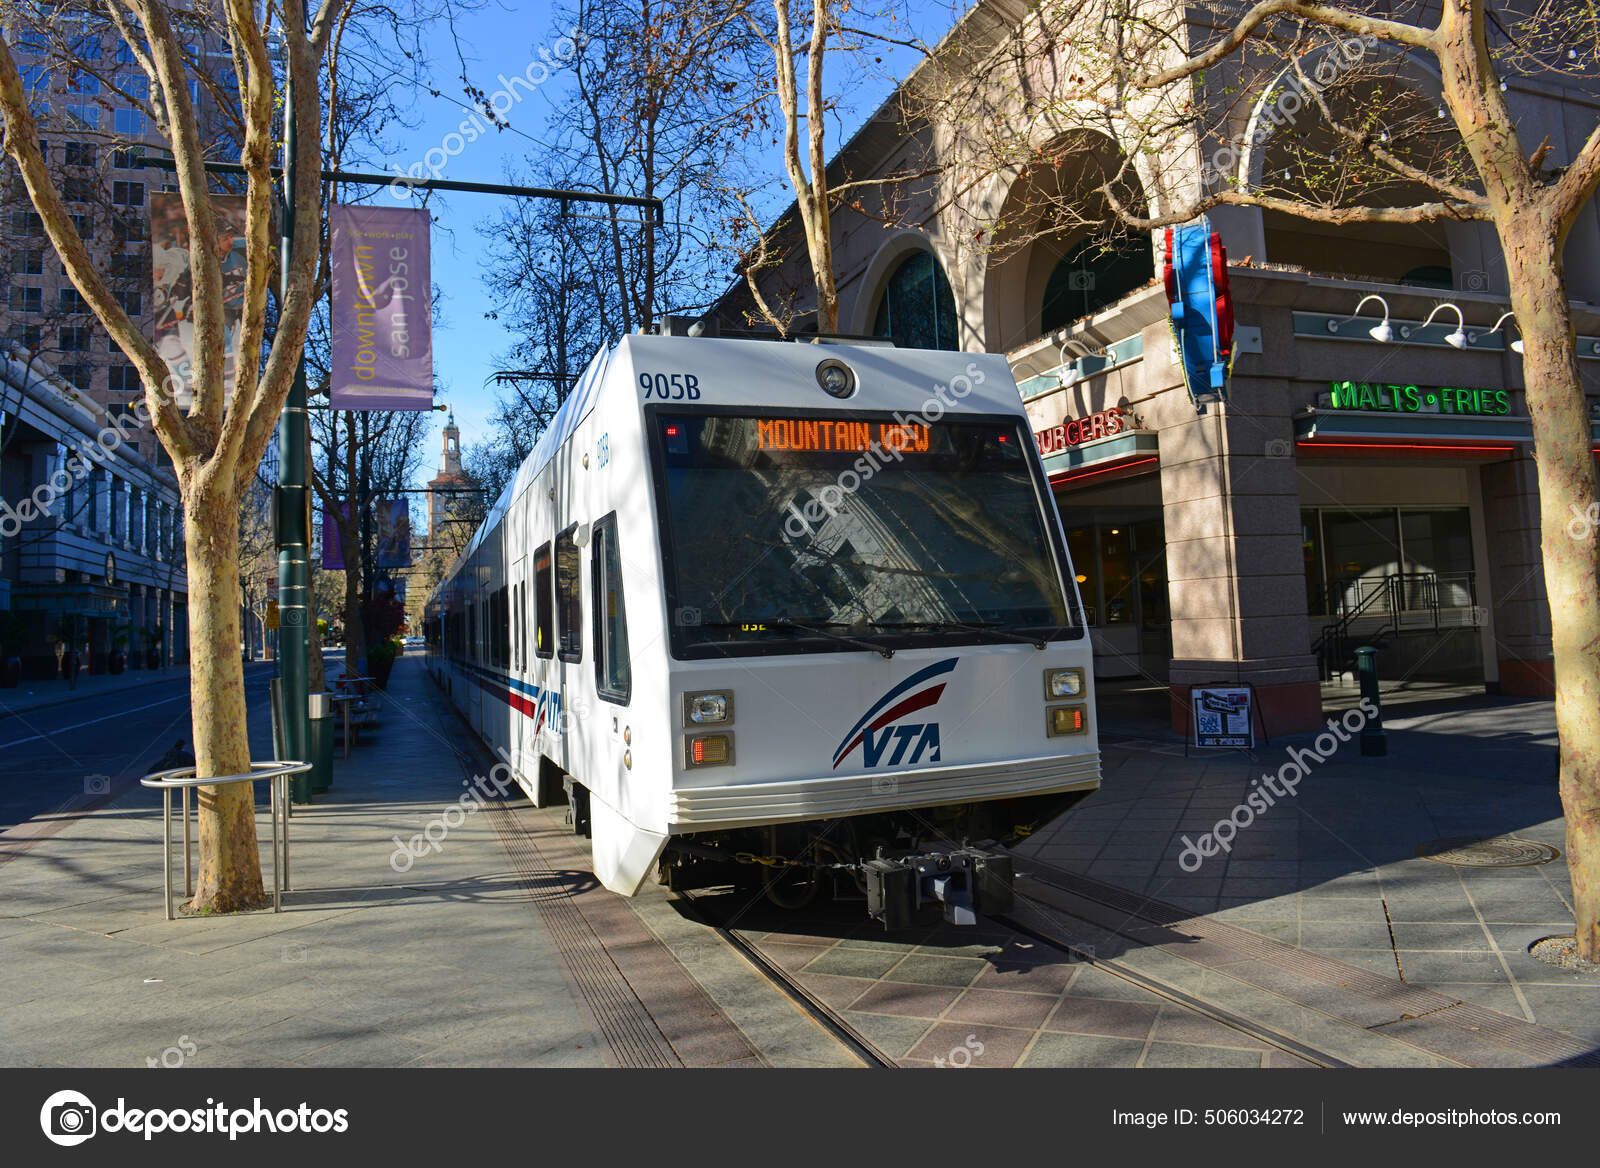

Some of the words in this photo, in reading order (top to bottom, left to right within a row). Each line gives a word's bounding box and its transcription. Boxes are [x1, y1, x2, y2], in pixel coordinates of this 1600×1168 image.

[384, 247, 415, 301] jose
[351, 245, 375, 380] downtown
[391, 312, 410, 358] san
[639, 372, 701, 401] 905B
[1329, 380, 1420, 412] MALTS
[1438, 387, 1511, 415] FRIES
[757, 419, 871, 451] MOUNTAIN
[879, 423, 929, 453] VIEW
[862, 722, 941, 768] VTA
